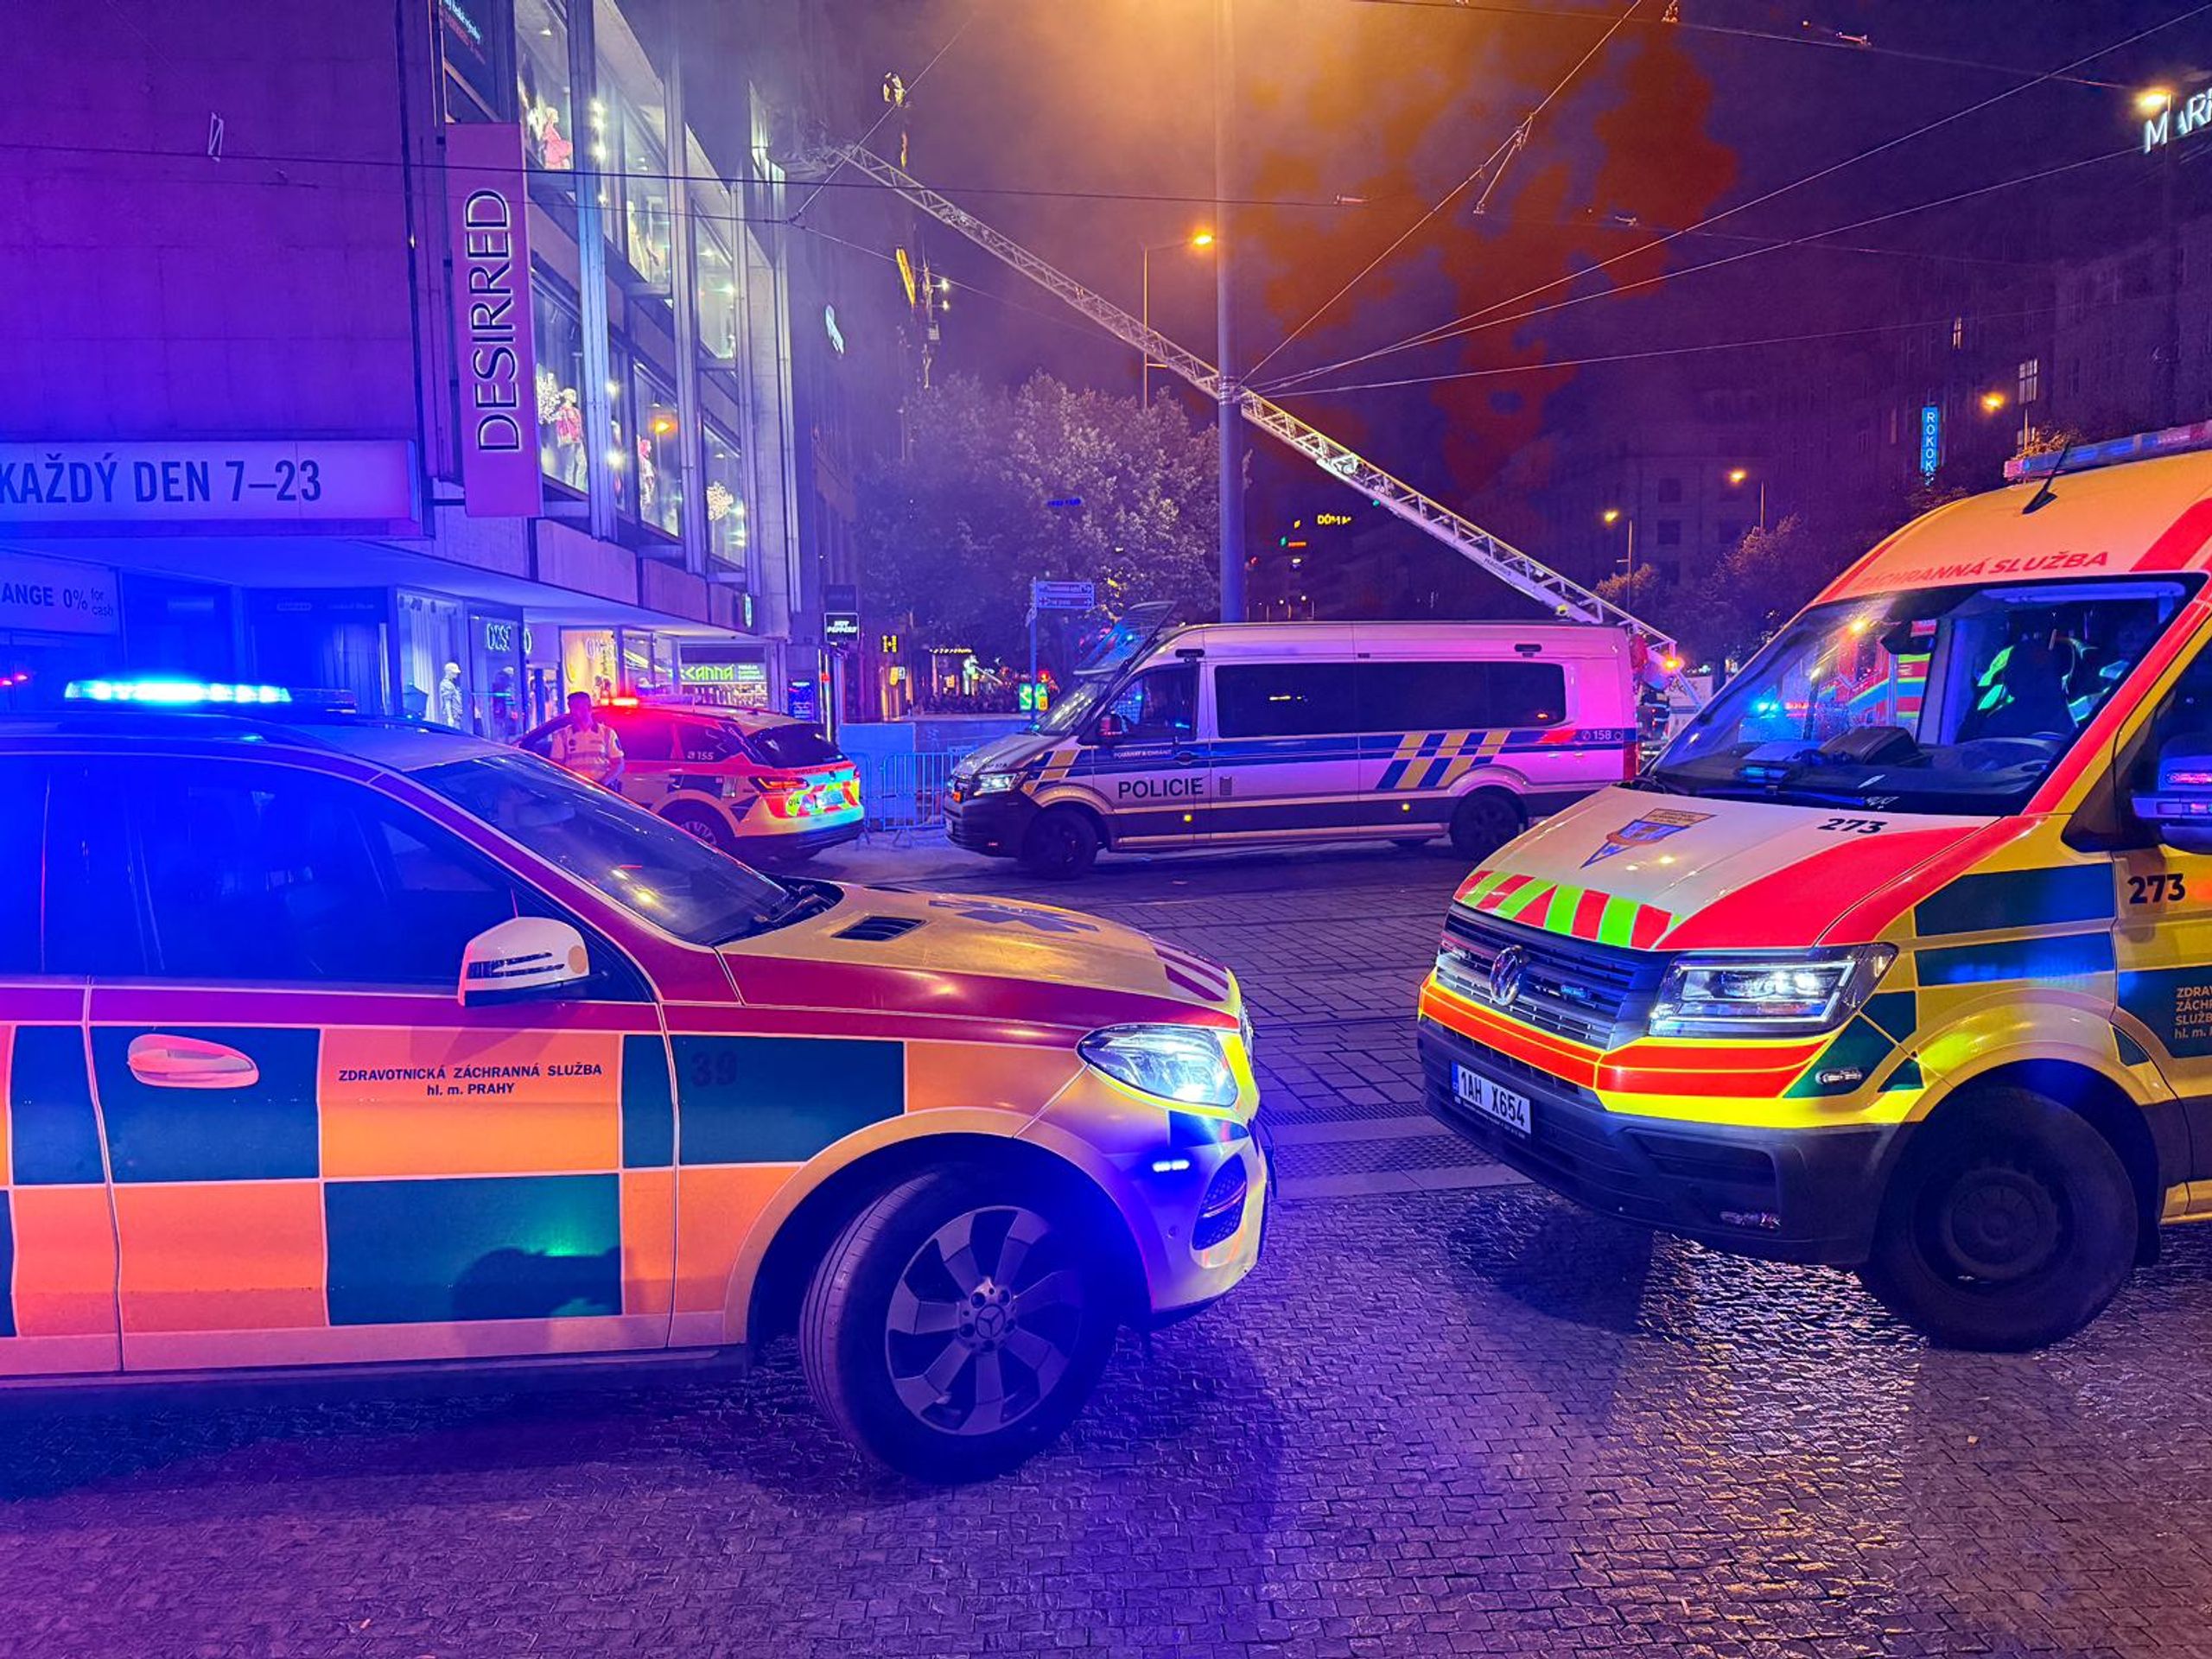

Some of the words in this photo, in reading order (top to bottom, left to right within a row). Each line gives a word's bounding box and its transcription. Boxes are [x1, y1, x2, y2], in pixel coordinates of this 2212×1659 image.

[465, 190, 520, 450] DESIRRED
[0, 452, 118, 503] KAŽDÝ
[133, 461, 210, 502] DEN
[1988, 551, 2108, 573] SLUŽBA
[2, 582, 54, 607] ANGE
[63, 588, 87, 610] 0%
[1593, 730, 1611, 741] 158
[1118, 778, 1204, 798] POLICIE
[1817, 818, 1888, 834] 273
[2127, 873, 2185, 905] 273
[2176, 986, 2212, 998] ZDRA
[339, 1065, 446, 1081] ZDRAVOTNICKÁ
[454, 1064, 540, 1078] ZÁCHRANNÁ
[548, 1062, 602, 1077] SLUŽBA
[692, 1052, 738, 1086] 39
[427, 1084, 442, 1096] hl.
[448, 1085, 463, 1095] m.
[467, 1083, 514, 1095] PRAHY
[1461, 1071, 1482, 1104] 1AH
[1492, 1084, 1525, 1126] X654
